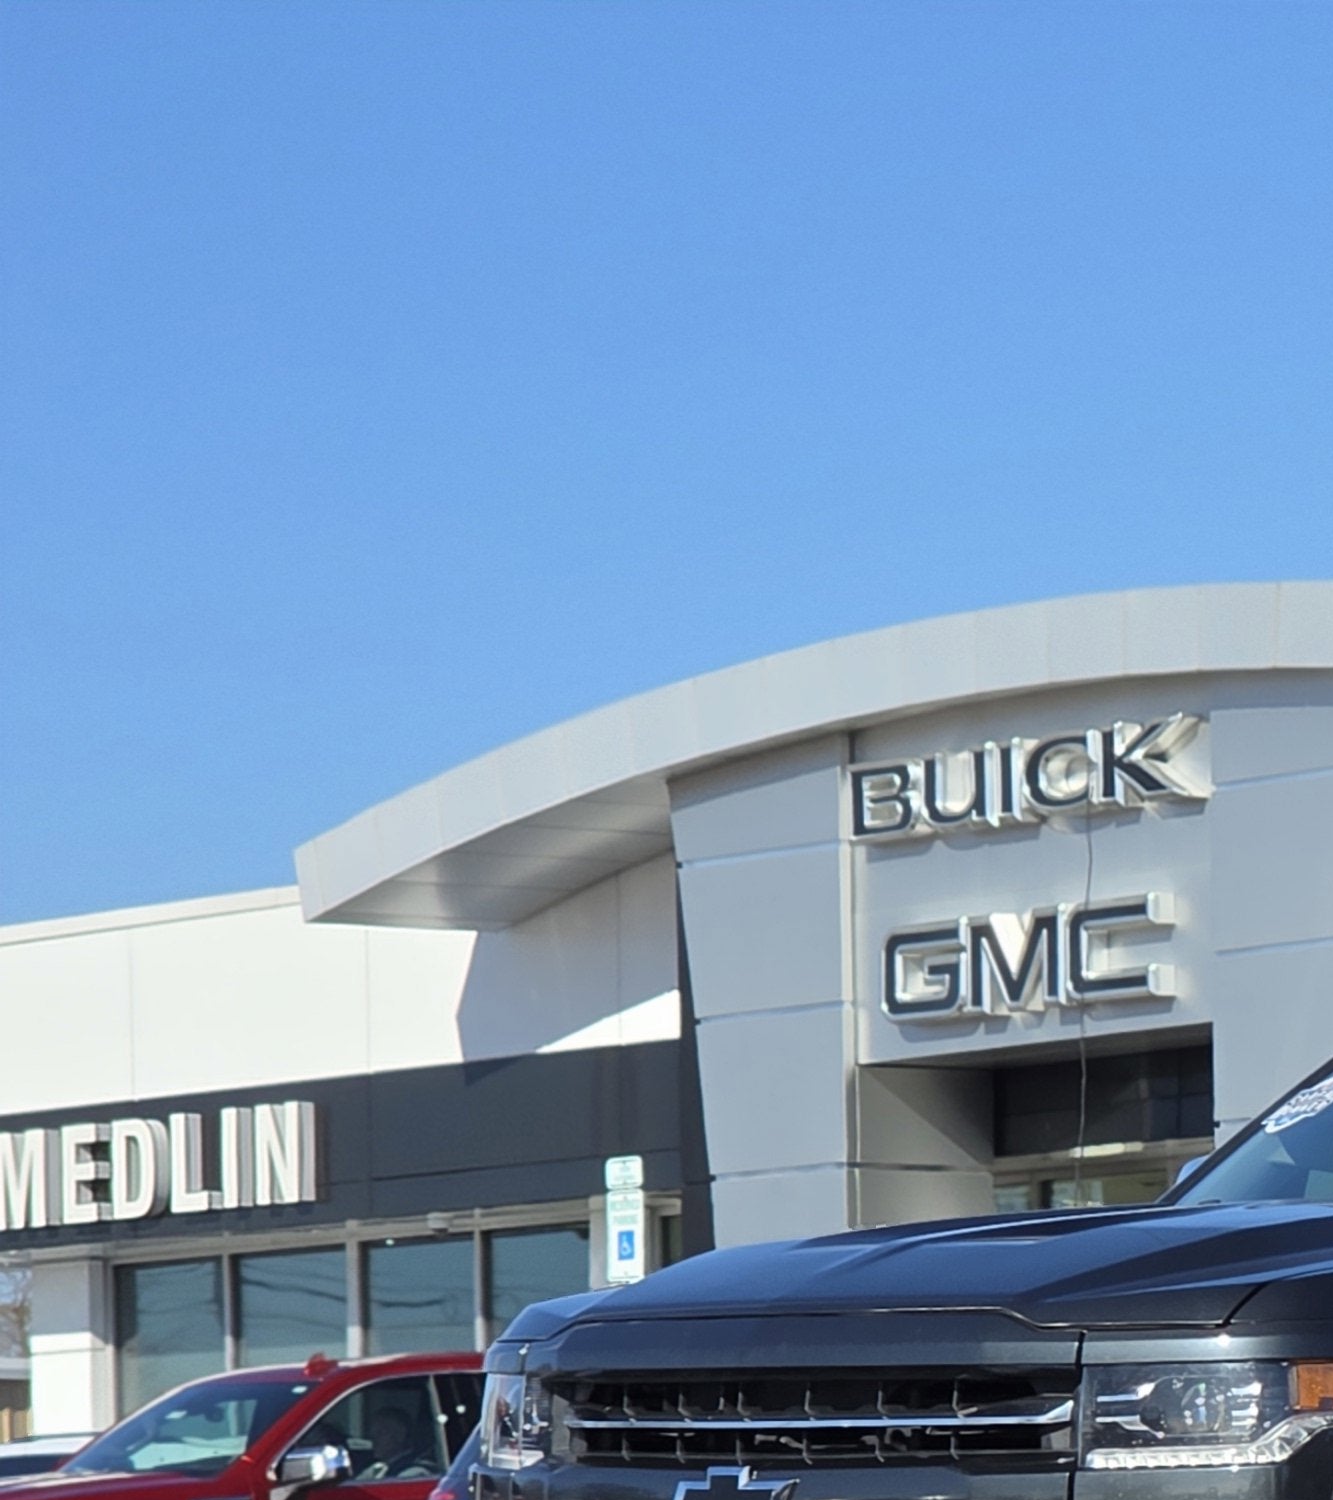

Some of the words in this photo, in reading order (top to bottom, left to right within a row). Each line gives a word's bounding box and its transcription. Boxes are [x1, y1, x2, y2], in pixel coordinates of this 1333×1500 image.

[850, 713, 1205, 840] BUICK
[882, 892, 1175, 1021] GMC
[0, 1100, 316, 1232] MEDLIN
